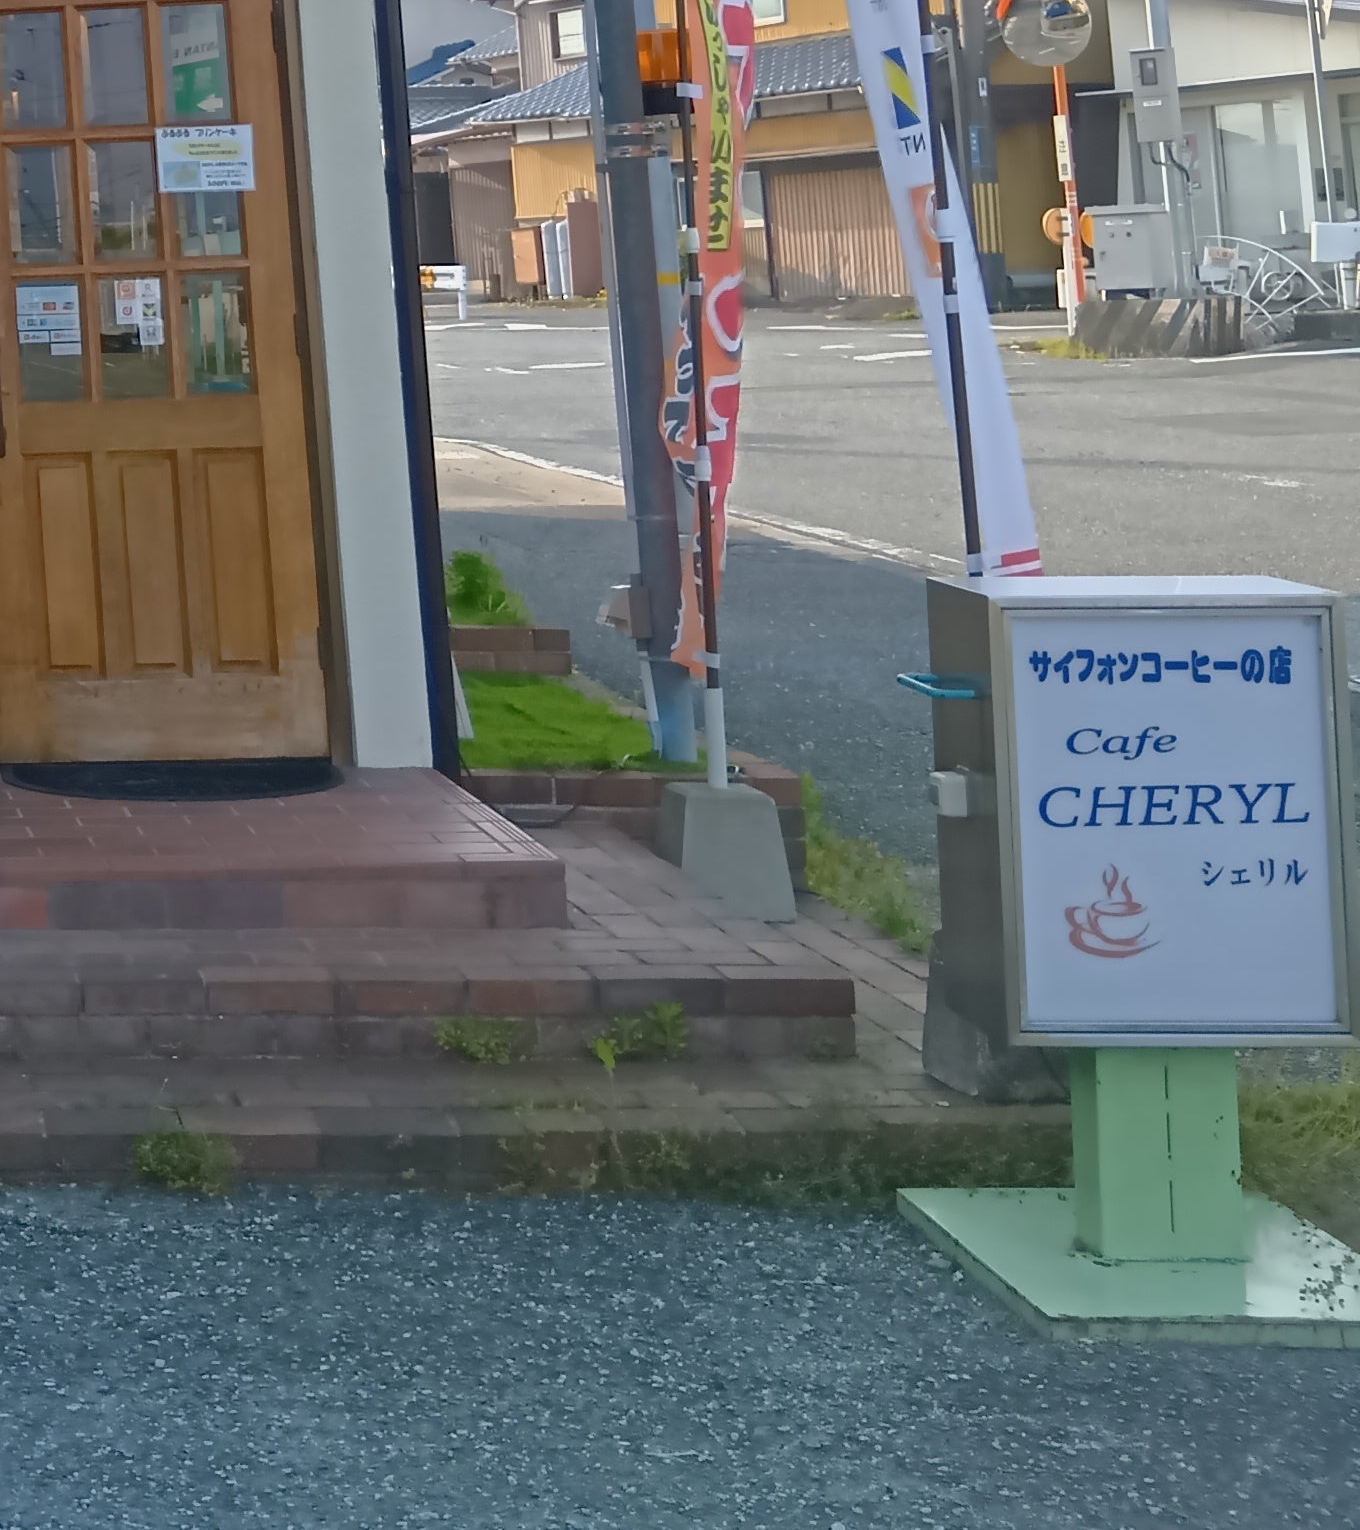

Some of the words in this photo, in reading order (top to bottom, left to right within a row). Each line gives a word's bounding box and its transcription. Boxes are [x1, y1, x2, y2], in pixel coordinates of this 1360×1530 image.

[1029, 645, 1292, 685] サイフォンコーヒーの店
[1066, 725, 1178, 761] Cafe
[1038, 782, 1310, 829] CHERYL
[1201, 858, 1309, 887] シェリル
